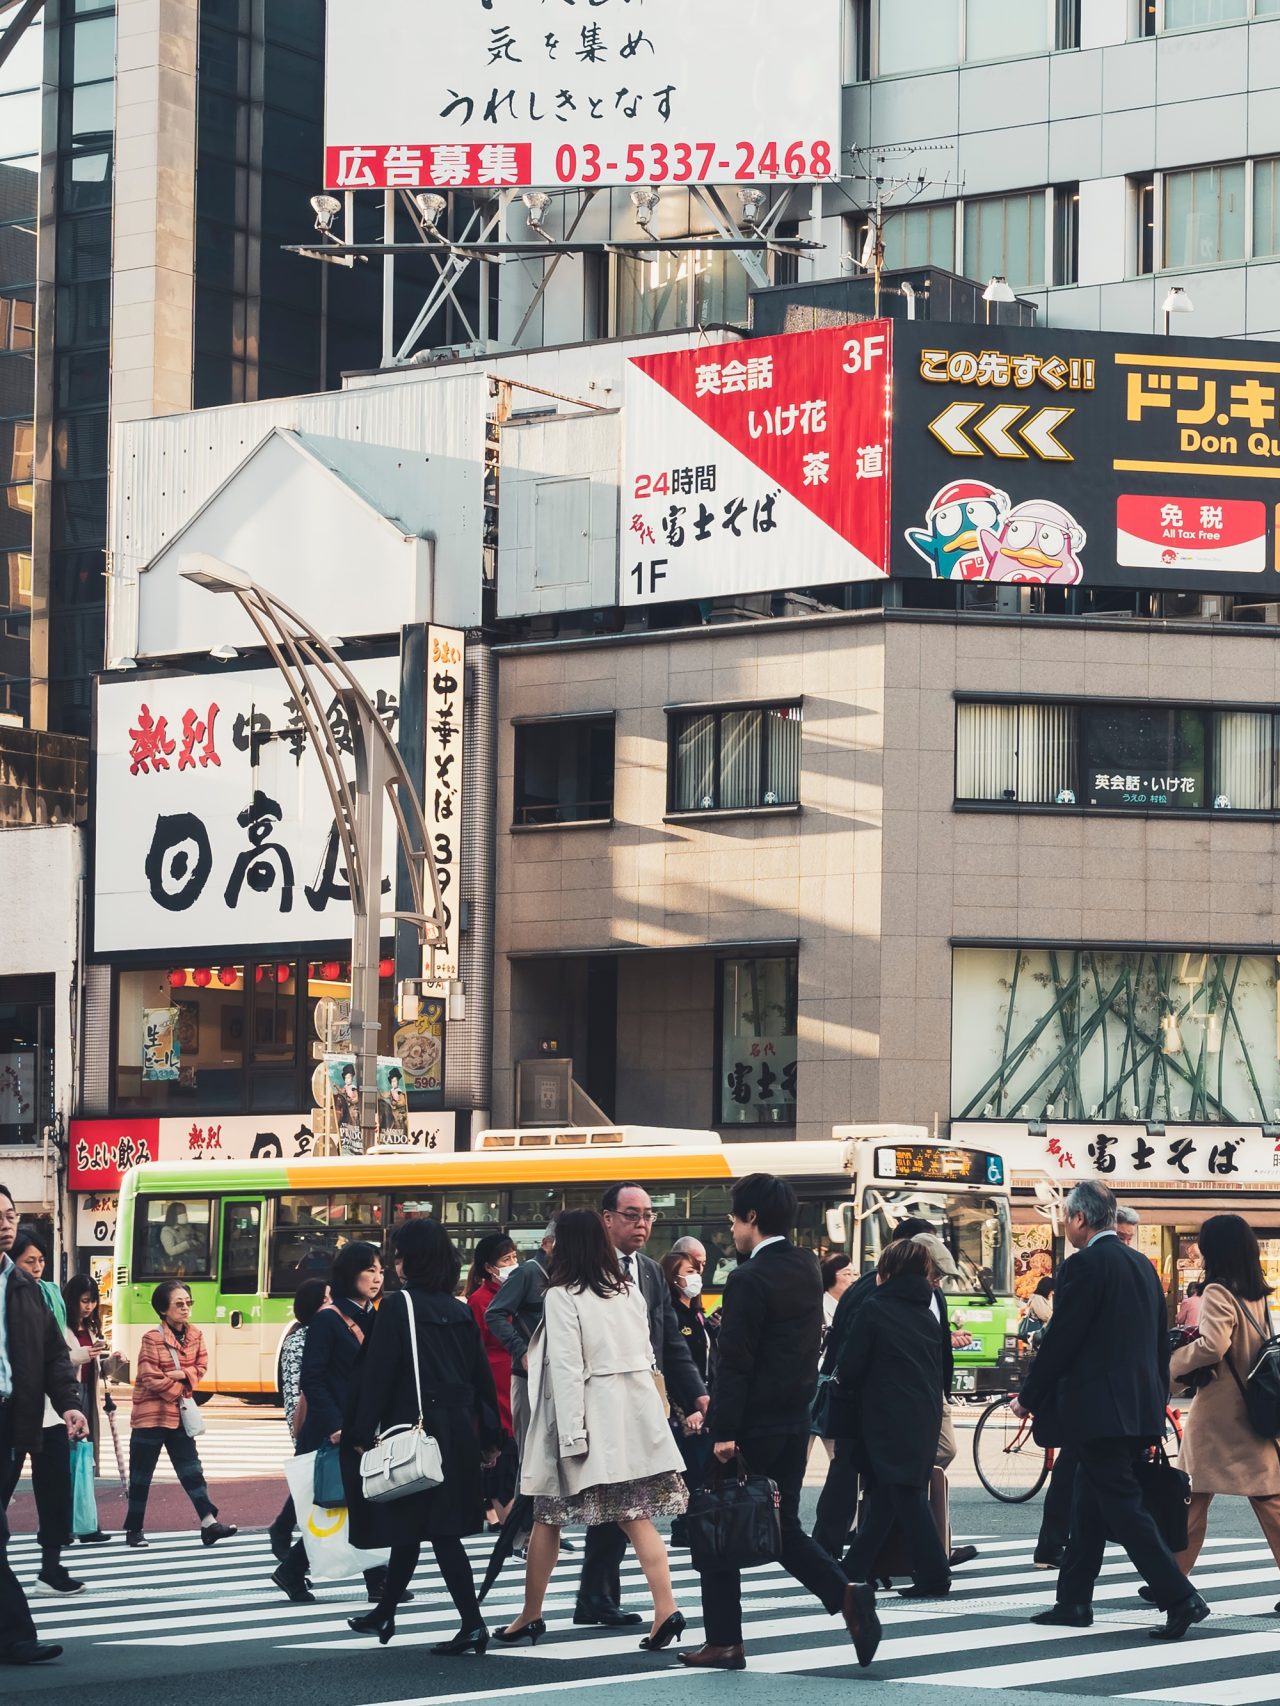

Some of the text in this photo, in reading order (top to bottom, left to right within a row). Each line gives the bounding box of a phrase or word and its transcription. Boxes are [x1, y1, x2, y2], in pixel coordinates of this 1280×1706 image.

[485, 25, 656, 66] 気を集め
[439, 85, 678, 126] うれしきとなす
[336, 145, 519, 186] 広告募集
[555, 140, 832, 183] 03-5337-2468
[842, 336, 885, 374] 3F
[919, 349, 1096, 390] この先すぐ!!
[696, 355, 773, 397] 英会話
[748, 400, 827, 439] いけ花
[1181, 429, 1237, 454] Don
[634, 464, 717, 499] 24時間
[803, 445, 883, 487] 茶道
[662, 488, 781, 548] 富士そば
[1160, 503, 1224, 529] 免税
[1162, 529, 1220, 540] All Tax Free
[631, 559, 668, 595] 1F
[129, 702, 221, 776] 熱烈
[1095, 774, 1195, 794] 英会話・いけ花
[1122, 793, 1146, 803] うえの
[144, 1025, 162, 1049] 生
[75, 1136, 151, 1172] ちょい飲み
[188, 1124, 222, 1150] 熱烈
[1087, 1133, 1246, 1175] 富士そば
